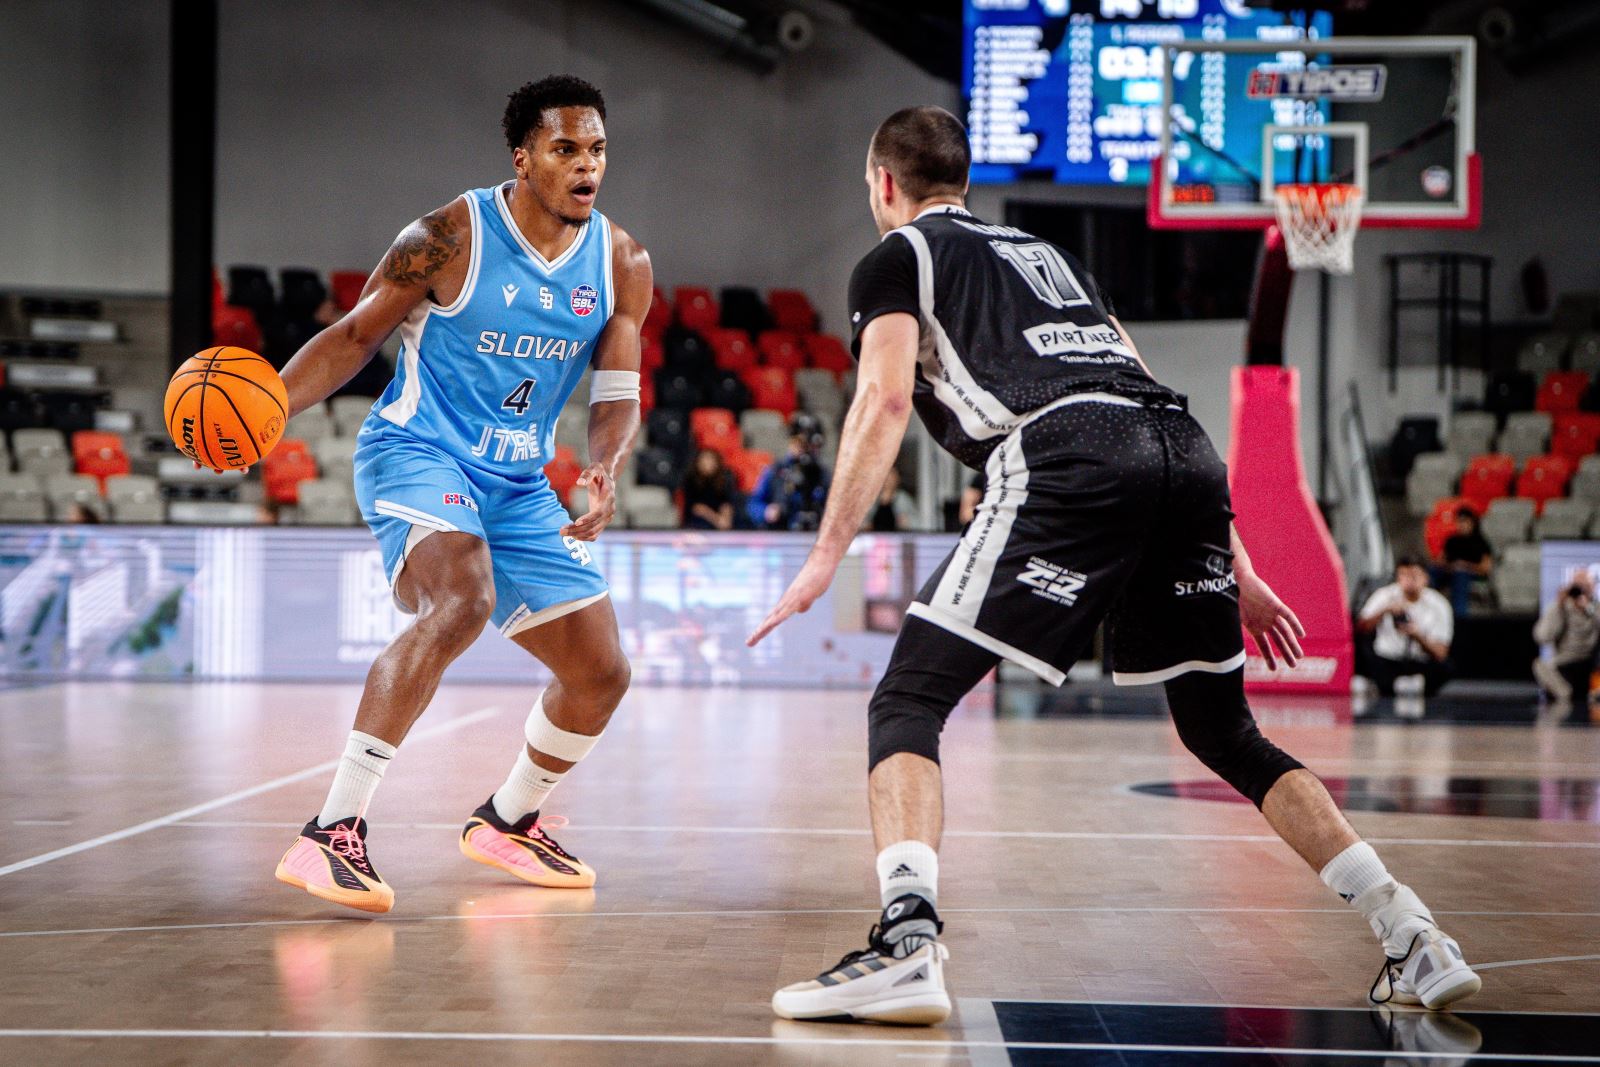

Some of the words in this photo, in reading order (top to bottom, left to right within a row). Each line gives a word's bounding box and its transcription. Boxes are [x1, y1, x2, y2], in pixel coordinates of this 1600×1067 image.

[1287, 70, 1374, 93] TIPOS
[988, 240, 1092, 309] 17
[573, 297, 593, 309] SBL
[477, 330, 587, 361] SLOVAN
[1039, 330, 1124, 348] PARTNER
[501, 378, 536, 416] 4
[219, 438, 246, 467] EVO
[958, 574, 971, 592] ARE
